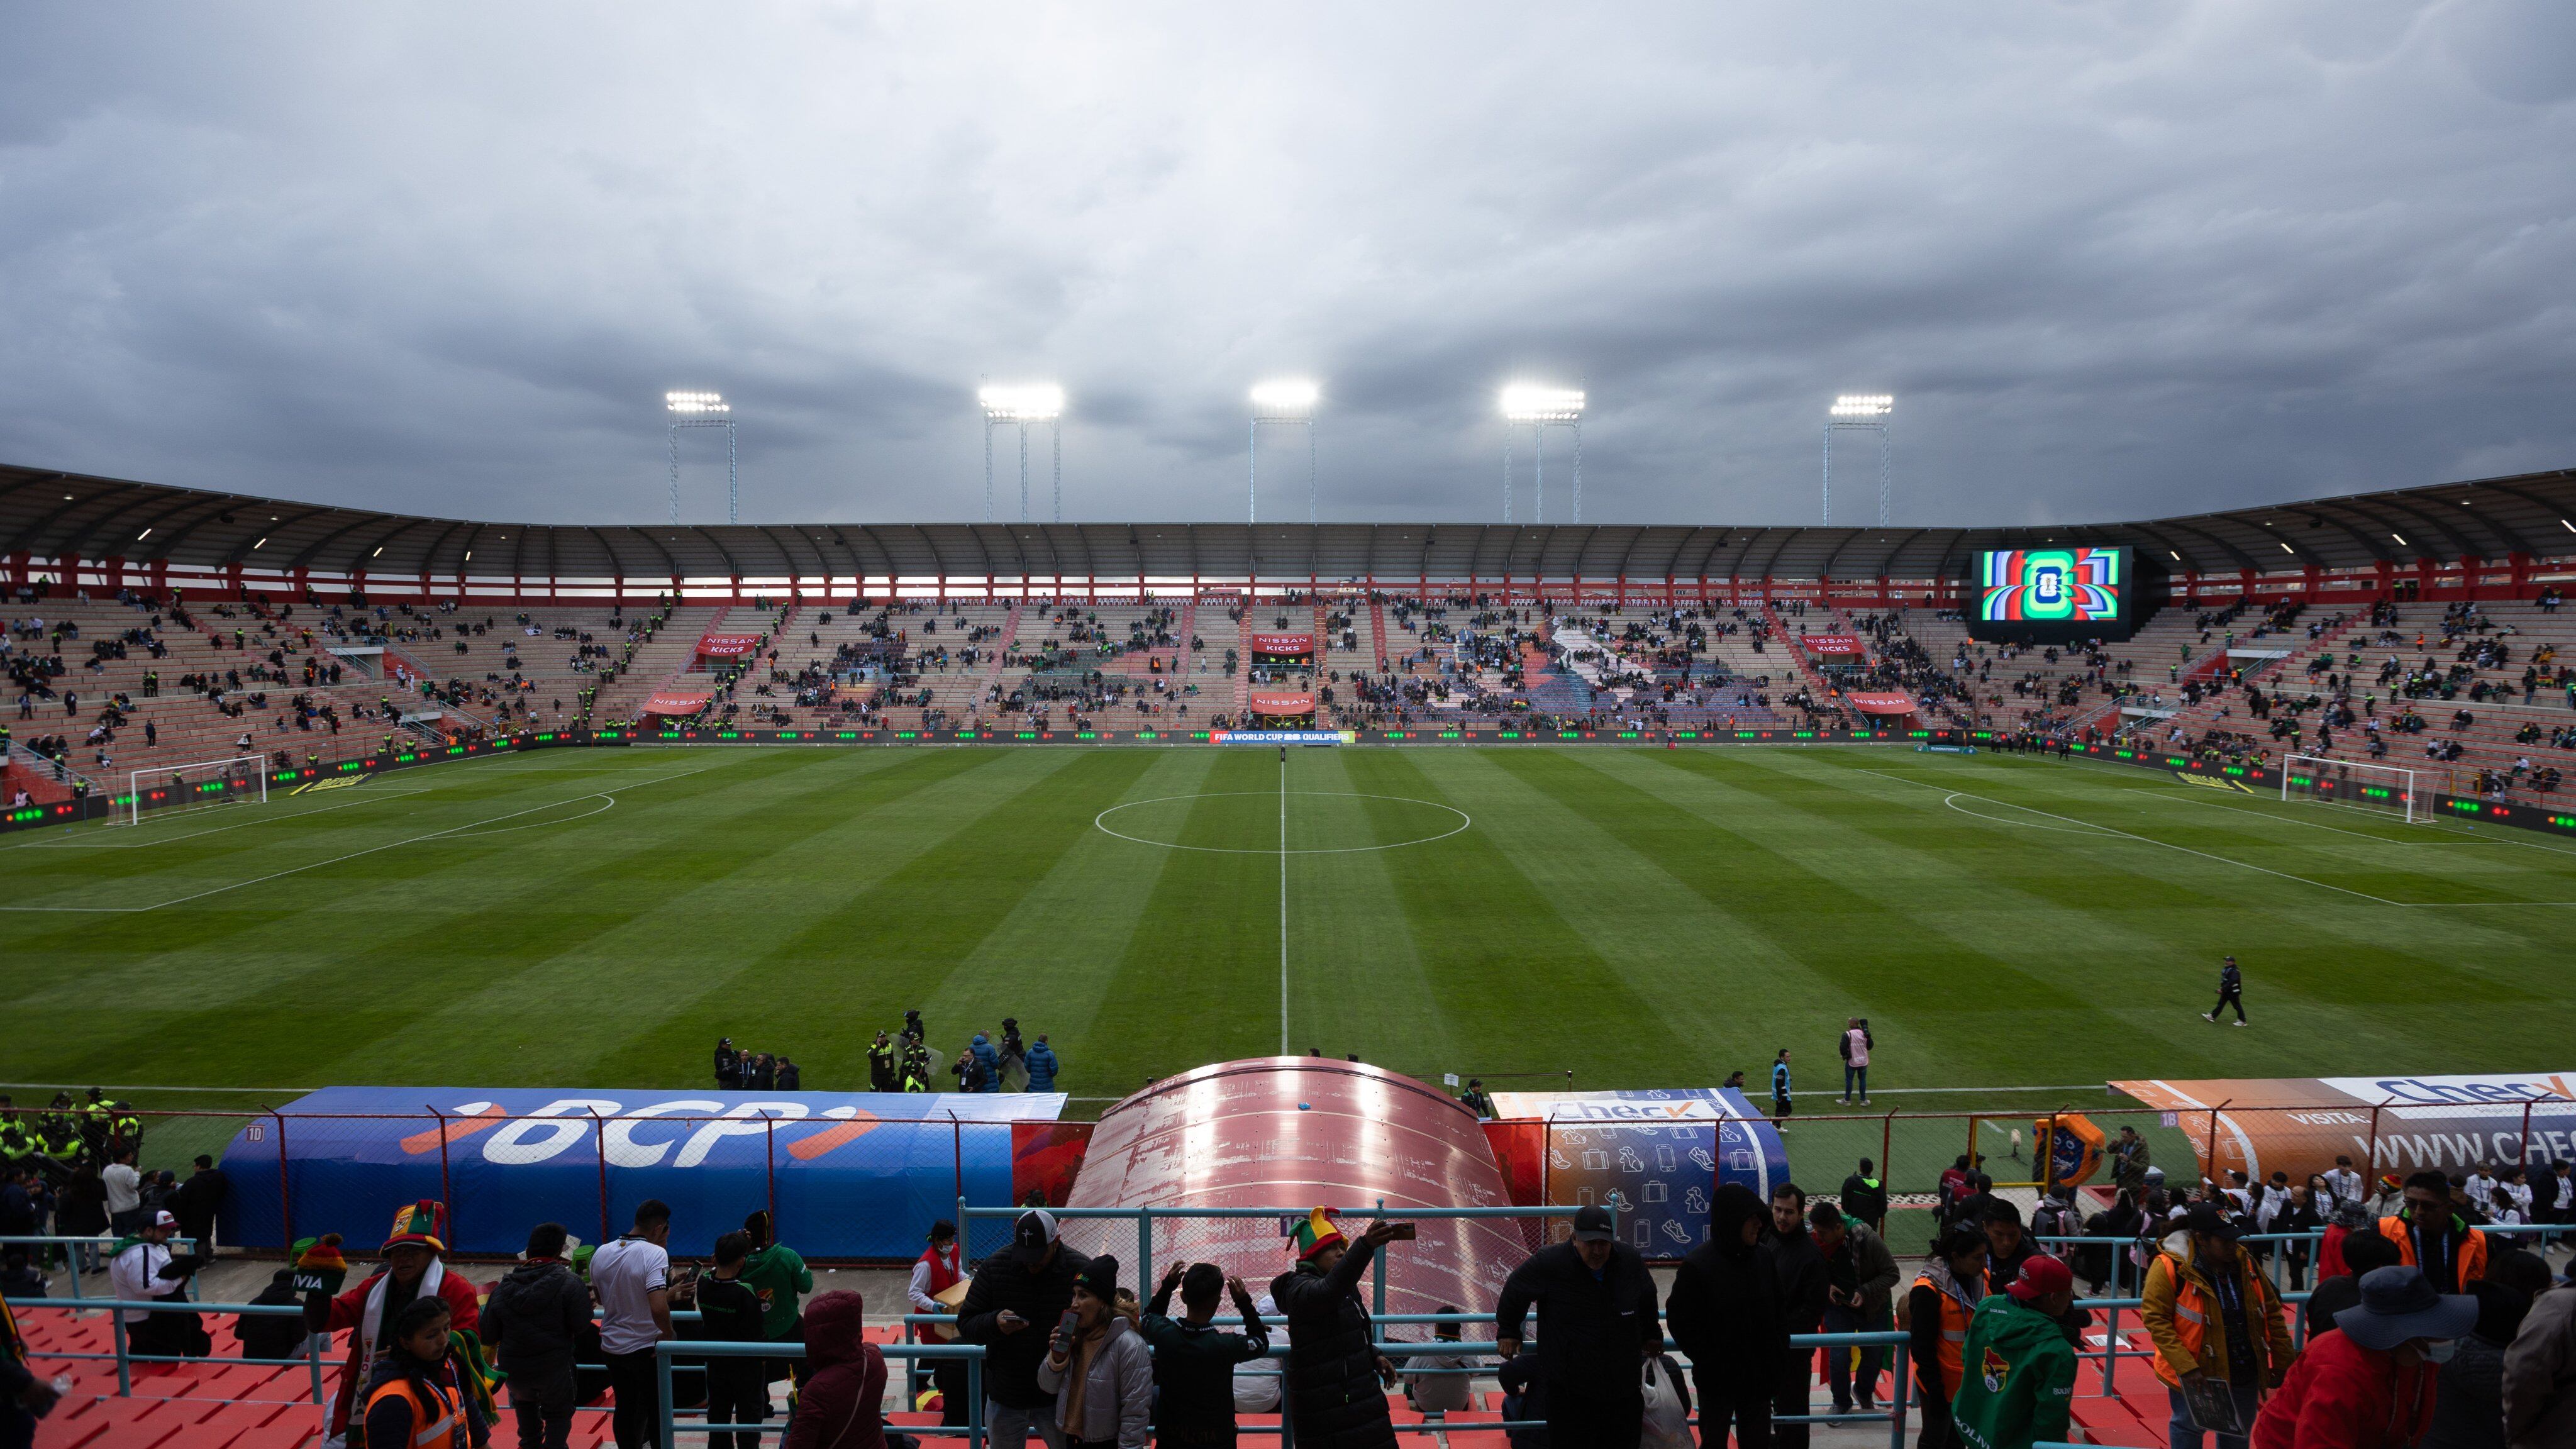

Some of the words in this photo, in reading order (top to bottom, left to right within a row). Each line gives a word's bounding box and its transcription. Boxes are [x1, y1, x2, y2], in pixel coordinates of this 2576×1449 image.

[2162, 1113, 2177, 1126] 1B
[2287, 1113, 2372, 1124] VISITA:
[249, 1128, 262, 1141] 1D
